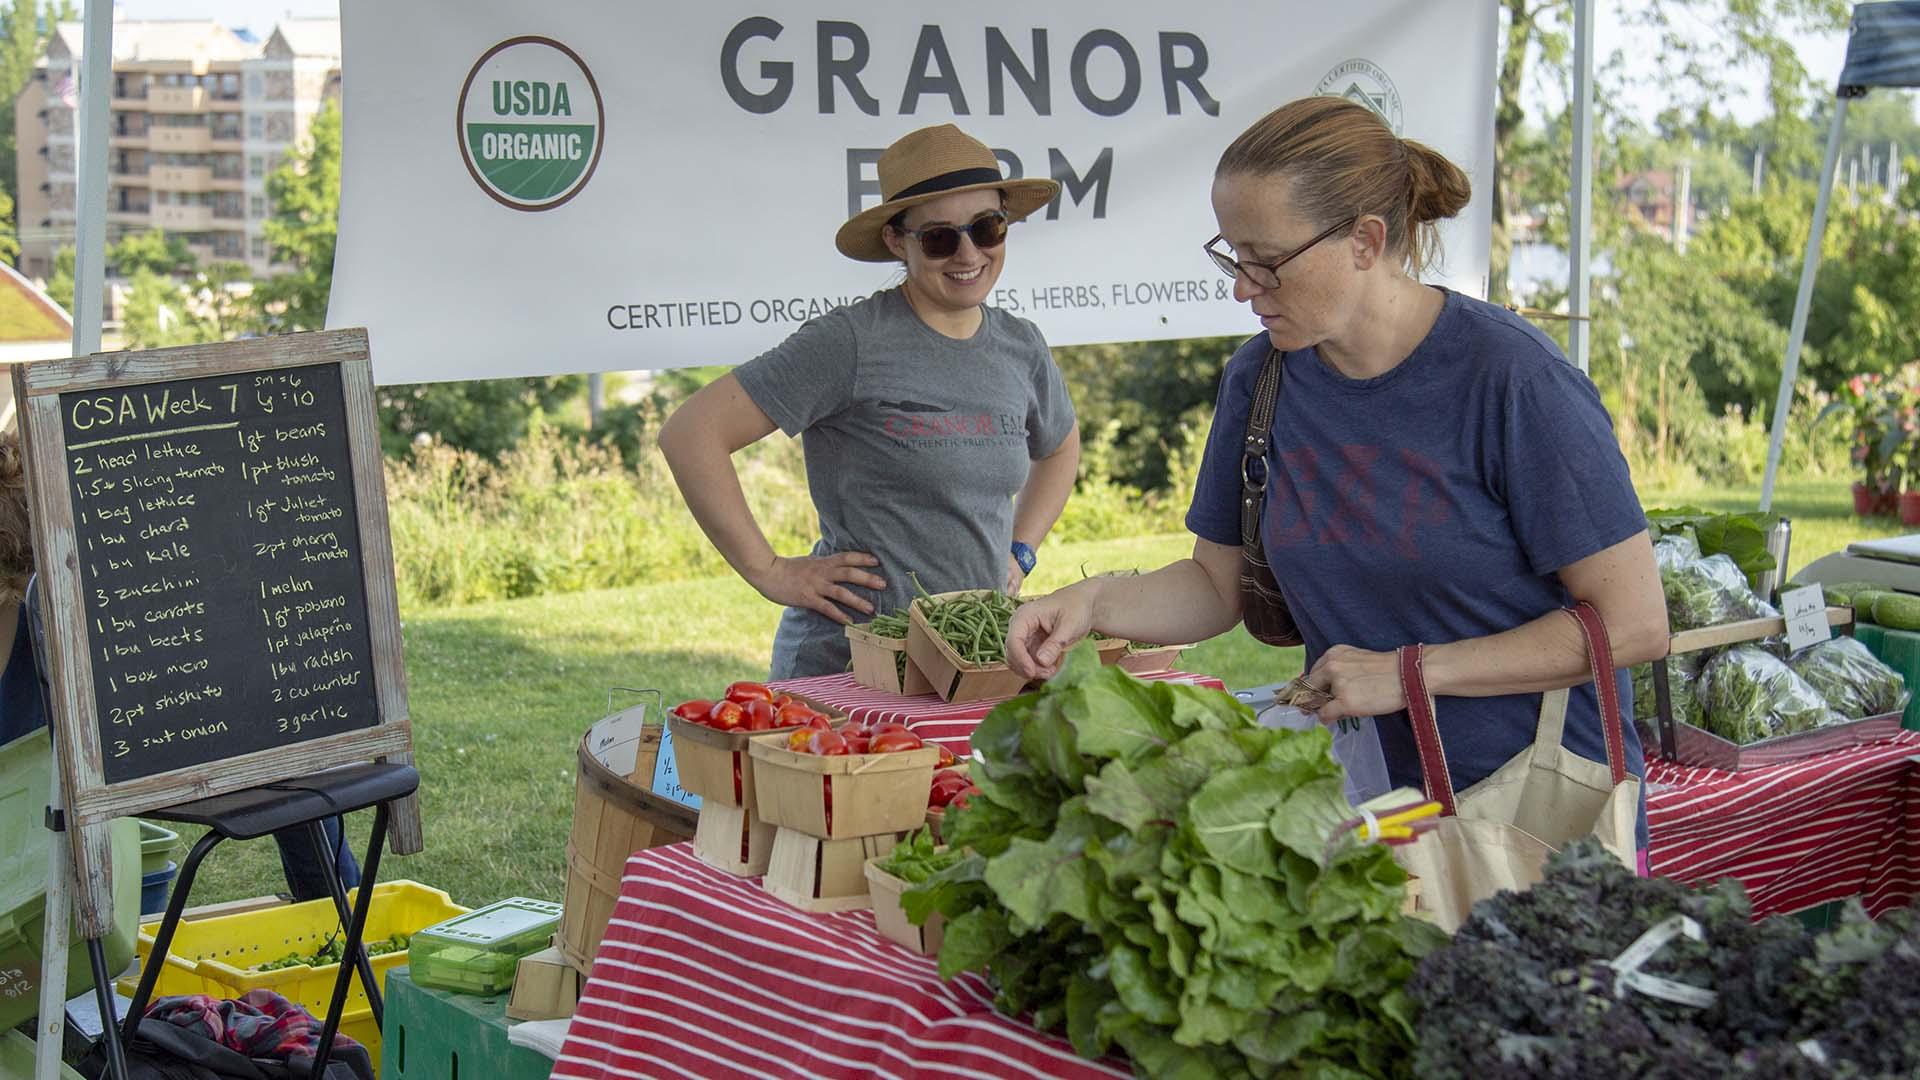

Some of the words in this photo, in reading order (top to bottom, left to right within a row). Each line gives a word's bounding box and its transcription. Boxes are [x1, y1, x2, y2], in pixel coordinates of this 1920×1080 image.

[720, 16, 1221, 117] GRANOR
[492, 80, 572, 116] USDA
[482, 132, 582, 160] ORGANIC
[846, 147, 1113, 222] FM
[1032, 285, 1106, 310] HERBS,
[1112, 280, 1209, 305] FLOWERS
[1215, 279, 1229, 300] &
[607, 301, 742, 330] CERTIFIED
[72, 393, 137, 430] CSA
[143, 387, 213, 425] Week
[219, 383, 239, 413] 7
[275, 423, 326, 442] beans
[73, 456, 93, 475] 2
[97, 449, 137, 471] head
[145, 441, 201, 461] lettuce
[175, 462, 226, 480] tomato
[276, 453, 320, 471] blush
[281, 466, 336, 486] tomato
[97, 506, 132, 525] bag
[138, 494, 196, 512] lettuce
[281, 494, 328, 513] Juliet
[296, 508, 343, 523] tomato
[101, 533, 127, 546] bu
[139, 516, 190, 540] chard
[292, 531, 339, 550] cherry
[108, 558, 134, 571] bu
[301, 548, 349, 563] tomato
[96, 588, 110, 607] 3
[113, 570, 201, 601] zucchini
[111, 616, 137, 633] bu
[144, 601, 205, 623] carrots
[295, 595, 346, 621] poblano
[115, 644, 142, 656] bu
[148, 627, 205, 647] beets
[124, 669, 158, 684] box
[166, 658, 209, 675] micro
[304, 648, 354, 670] radish
[155, 684, 223, 711] shishito
[289, 670, 361, 699] cucumber
[292, 705, 349, 734] garlic
[113, 740, 131, 758] 3
[180, 718, 229, 741] onion
